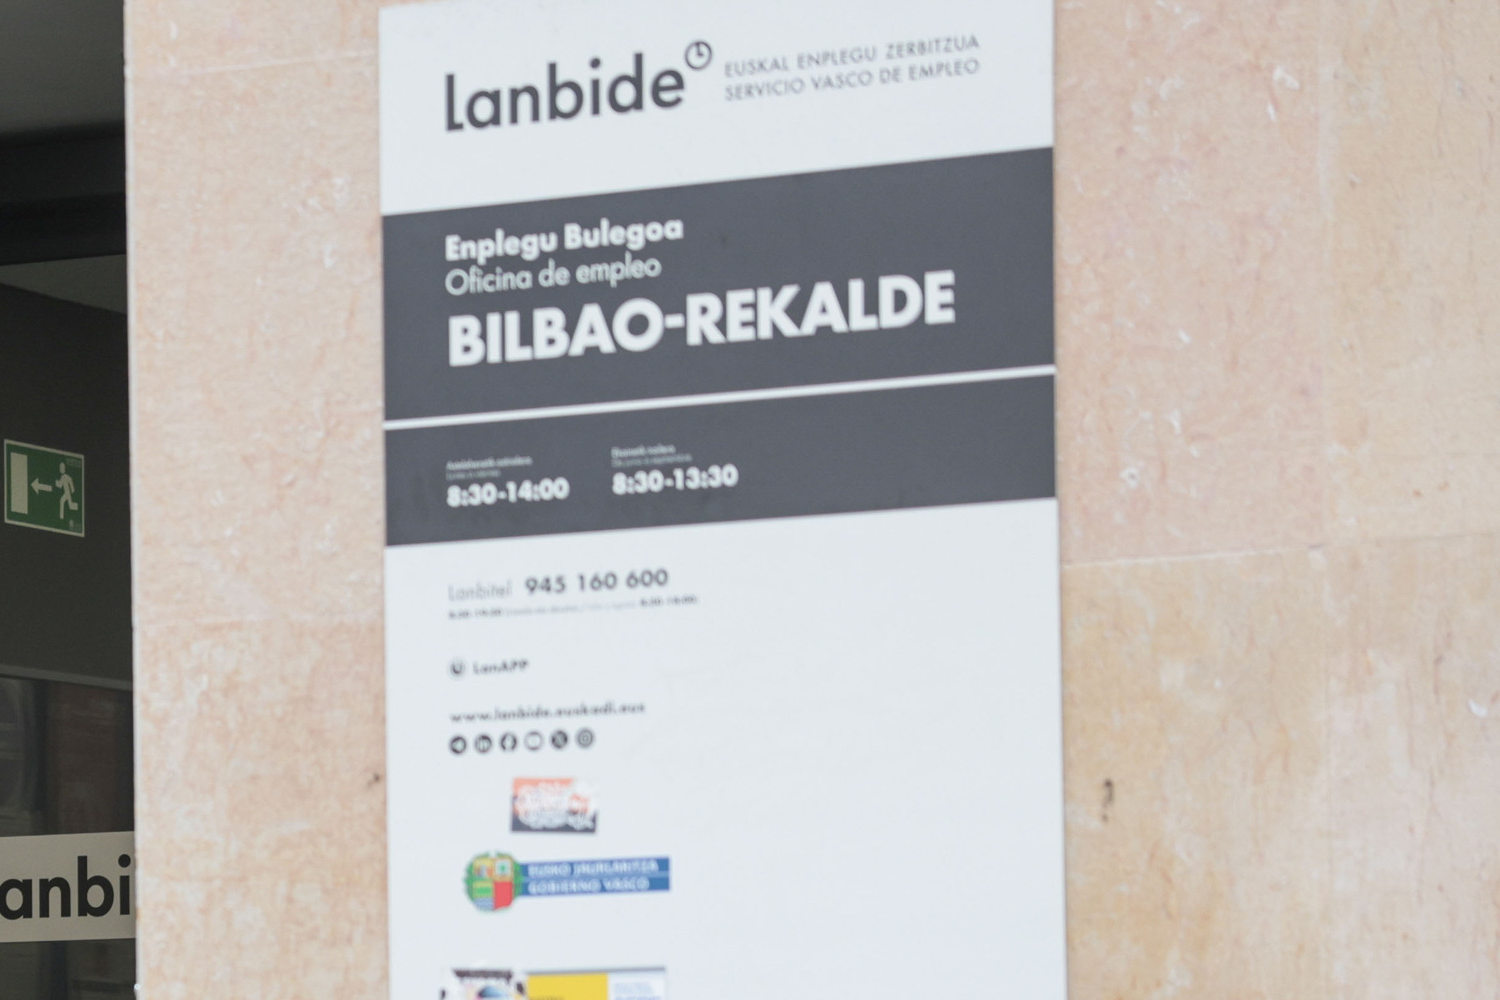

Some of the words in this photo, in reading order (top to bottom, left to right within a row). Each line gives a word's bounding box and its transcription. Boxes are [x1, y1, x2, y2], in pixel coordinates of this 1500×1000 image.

[724, 60, 789, 79] EUSKAL
[797, 46, 877, 69] ENPLEGU
[885, 34, 980, 60] ZERBITZUA
[724, 77, 805, 101] SERVICIO
[811, 69, 874, 91] VASCO
[879, 65, 901, 84] DE
[908, 57, 980, 81] EMPLEO
[445, 228, 558, 266] Enplegu
[564, 217, 684, 251] Bulegoa
[445, 264, 533, 296] Oficina
[538, 257, 571, 287] de
[576, 250, 662, 288] empleo
[448, 269, 956, 367] BILBAO-REKALDE
[446, 477, 570, 507] 8:30-14:00
[612, 463, 739, 495] 8:30-13:30
[525, 574, 567, 595] 945
[577, 571, 618, 592] 160
[625, 567, 669, 589] 600
[528, 862, 572, 878] EUSKO
[528, 879, 602, 895] GOBIERNO
[602, 876, 651, 892] VASCO
